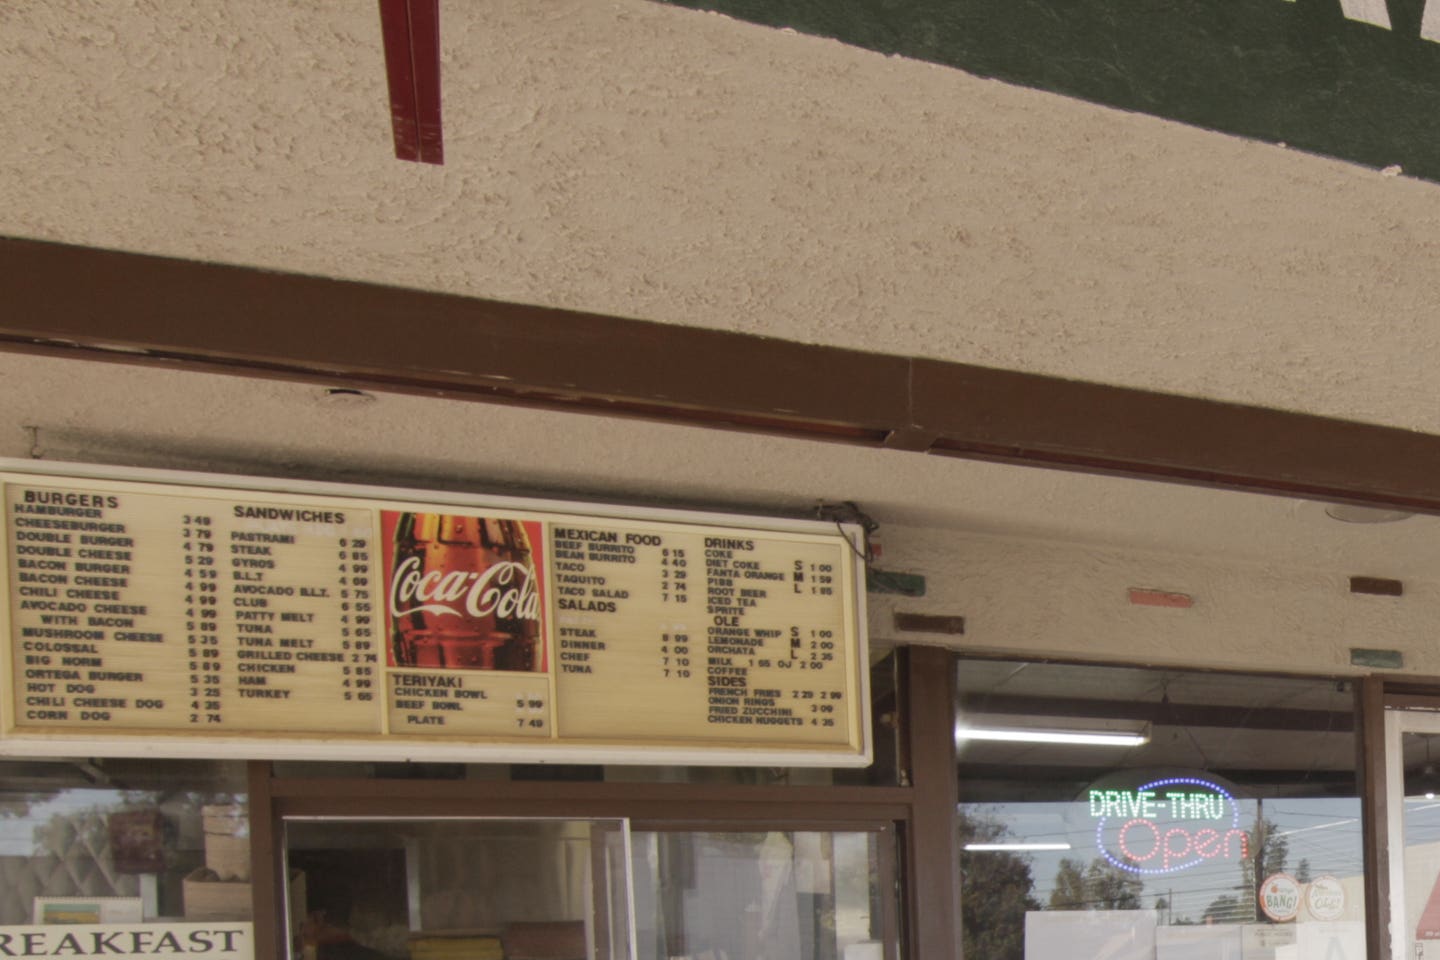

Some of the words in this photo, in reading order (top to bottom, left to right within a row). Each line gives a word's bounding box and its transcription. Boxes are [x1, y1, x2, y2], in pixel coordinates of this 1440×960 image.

[24, 490, 119, 509] BURGERS
[14, 503, 102, 519] HAMBURGER
[233, 505, 345, 524] SANDWICHES
[15, 517, 126, 533] CHEESEBURGER
[16, 531, 71, 544] DOUBLE
[80, 535, 134, 547] BURGER
[231, 531, 295, 544] PASTRAMI
[554, 528, 617, 542] MEXICAN
[626, 533, 662, 546] FOOD
[231, 544, 272, 555] STEAK
[555, 541, 582, 550] BEEF
[588, 543, 634, 554] BURRITO
[705, 538, 754, 551] DRINKS
[17, 545, 71, 557] DOUBLE
[78, 549, 132, 561] CHEESE
[555, 550, 584, 559] BEAN
[589, 553, 636, 564] BURRITO
[705, 550, 733, 559] COKE
[18, 559, 66, 571] BACON
[75, 562, 130, 574] BURGER
[232, 558, 275, 569] GYROS
[556, 562, 585, 572] TACO
[706, 559, 728, 567] DIET
[733, 561, 760, 569] COKE
[795, 560, 802, 570] S
[19, 572, 67, 584] BACON
[75, 576, 128, 587] CHEESE
[556, 574, 605, 585] TAQUITO
[707, 569, 740, 577] FANTA
[745, 571, 785, 580] ORANGE
[794, 572, 804, 582] M
[19, 586, 57, 597] CHILI
[67, 588, 120, 601] CHEESE
[234, 584, 294, 596] AVOCADO
[390, 556, 540, 620] Coca-Cola
[558, 586, 586, 596] TACO
[592, 588, 628, 599] SALAD
[708, 587, 734, 596] ROOT
[741, 589, 766, 598] BEER
[794, 584, 802, 594] L
[233, 598, 268, 607] CLUB
[558, 598, 616, 612] SALADS
[708, 597, 731, 605] ICED
[737, 598, 757, 607] TEA
[20, 601, 86, 613] AVOCADO
[94, 604, 147, 615] CHEESE
[707, 606, 745, 615] SPRITE
[40, 614, 78, 625] WITH
[88, 616, 134, 628] BACON
[235, 610, 274, 621] PATTY
[281, 613, 314, 622] MELT
[714, 615, 739, 627] OLE
[237, 624, 273, 634] TUNA
[560, 628, 596, 637] STEAK
[708, 627, 749, 636] ORANGE
[754, 629, 782, 638] WHIP
[791, 626, 799, 636] S
[22, 627, 104, 640] MUSHROOM
[114, 632, 163, 643] CHEESE
[237, 636, 273, 647] TUNA
[280, 639, 314, 648] MELT
[561, 640, 605, 650] DINNER
[708, 636, 764, 646] LEMONADE
[790, 638, 800, 648] M
[23, 641, 98, 653] COLOSSAL
[708, 646, 755, 655] ORCHATA
[237, 650, 292, 660] GRILLED
[296, 653, 345, 662] CHEESE
[561, 652, 590, 661] CHEF
[791, 650, 798, 659] L
[25, 655, 50, 665] BIG
[62, 657, 102, 667] NORM
[238, 663, 295, 673] CHICKEN
[562, 664, 592, 673] TUNA
[708, 667, 747, 675] COFFEE
[25, 669, 80, 680] ORTEGA
[89, 671, 143, 682] BURGER
[238, 676, 266, 685] HAM
[393, 674, 462, 688] TERIYAKI
[708, 676, 746, 687] SIDES
[27, 683, 55, 692] HOT
[67, 684, 95, 693] DOG
[238, 688, 290, 699] TURKEY
[394, 687, 448, 697] CHICKEN
[454, 690, 488, 699] BOWL
[709, 688, 747, 696] FRENCH
[754, 689, 781, 697] FRIES
[26, 696, 65, 707] CHILI
[73, 697, 126, 708] CHEESE
[136, 699, 164, 709] DOG
[395, 700, 425, 709] BEEF
[432, 701, 463, 711] BOWL
[708, 697, 739, 705] ONION
[744, 698, 775, 706] RINGS
[27, 710, 67, 720] CORN
[81, 711, 111, 721] DOG
[709, 706, 737, 714] FRIED
[743, 707, 792, 716] ZUCCHINI
[407, 715, 445, 725] PLATE
[708, 715, 752, 724] CHICKEN
[756, 717, 803, 725] NUGGETS
[1089, 790, 1224, 820] DRIVE-THRU
[1119, 818, 1249, 869] Open
